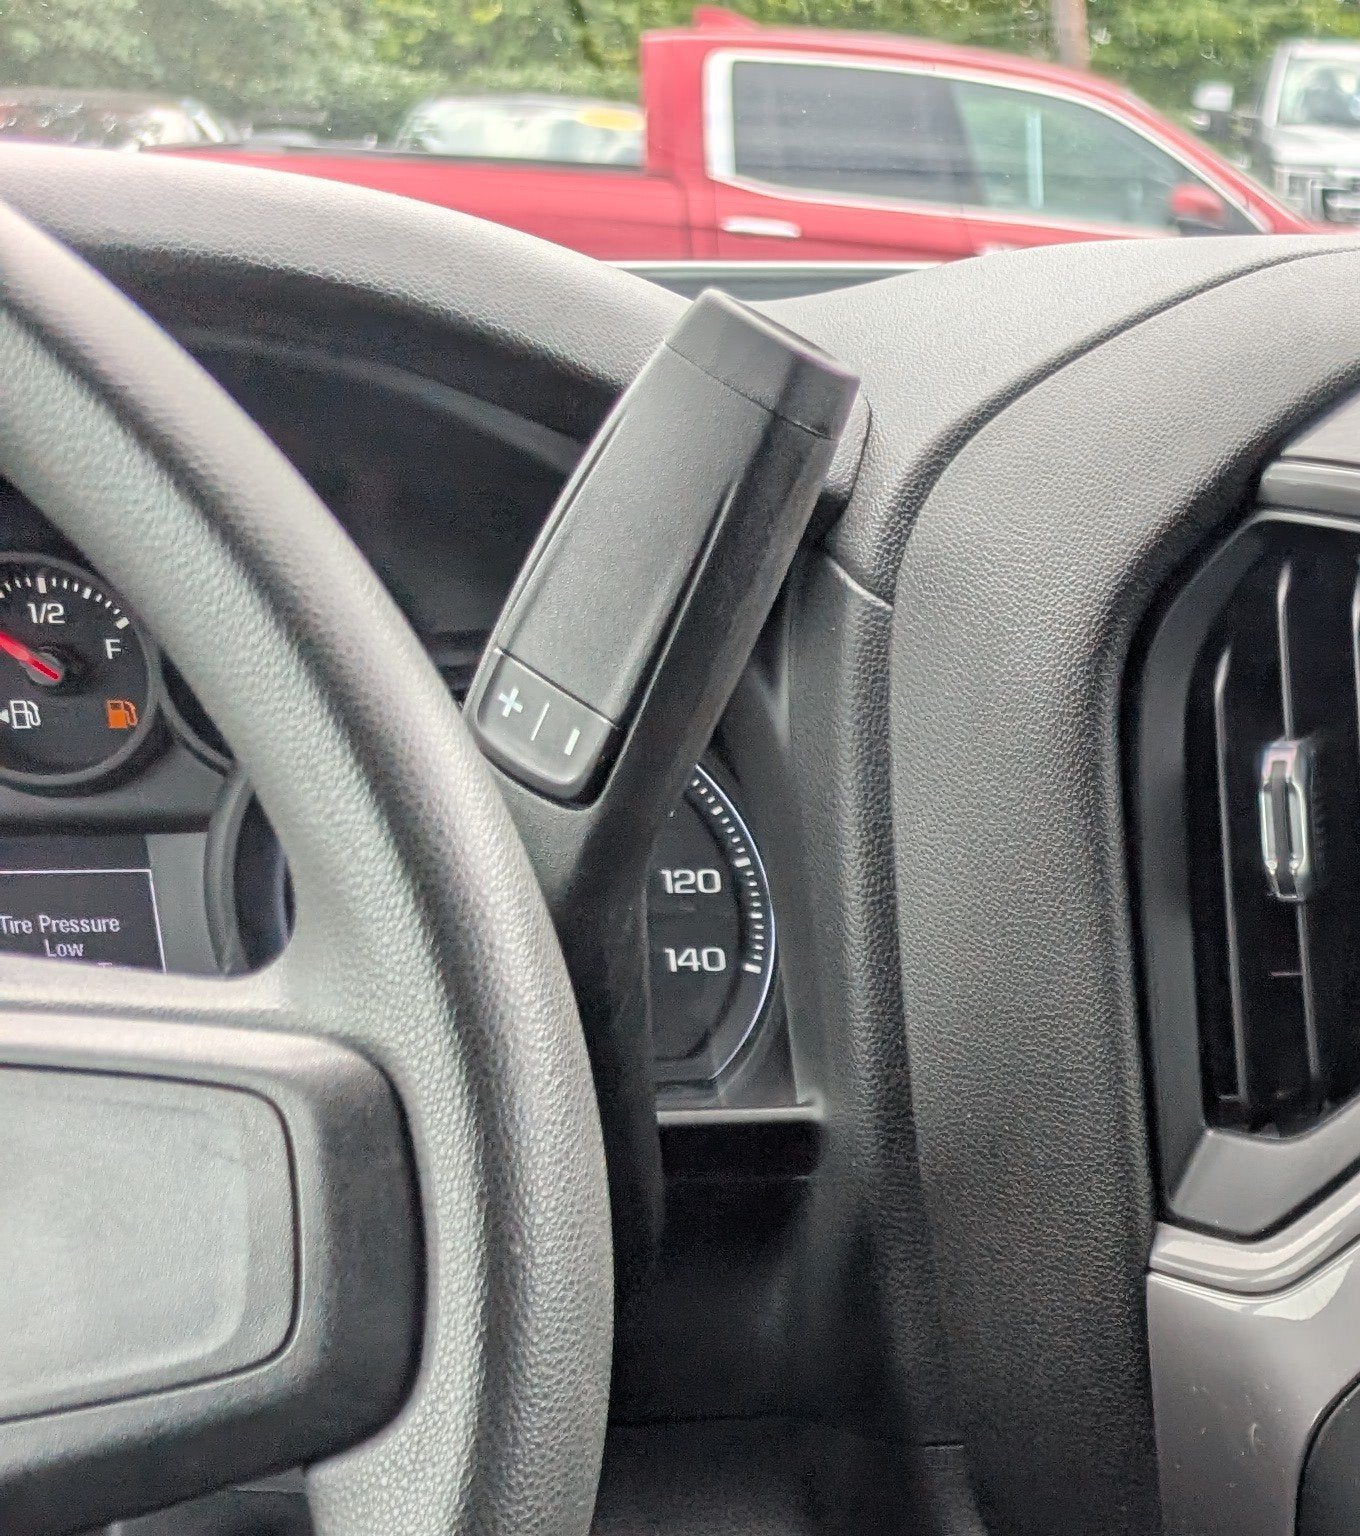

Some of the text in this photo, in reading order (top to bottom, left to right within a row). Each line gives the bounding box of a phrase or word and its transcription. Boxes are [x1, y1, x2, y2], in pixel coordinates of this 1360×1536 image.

[27, 602, 66, 625] 1/2
[104, 638, 122, 660] F
[660, 869, 722, 895] 120
[0, 914, 121, 934] Tire Pressure
[44, 939, 84, 958] Low
[664, 947, 727, 973] 140
